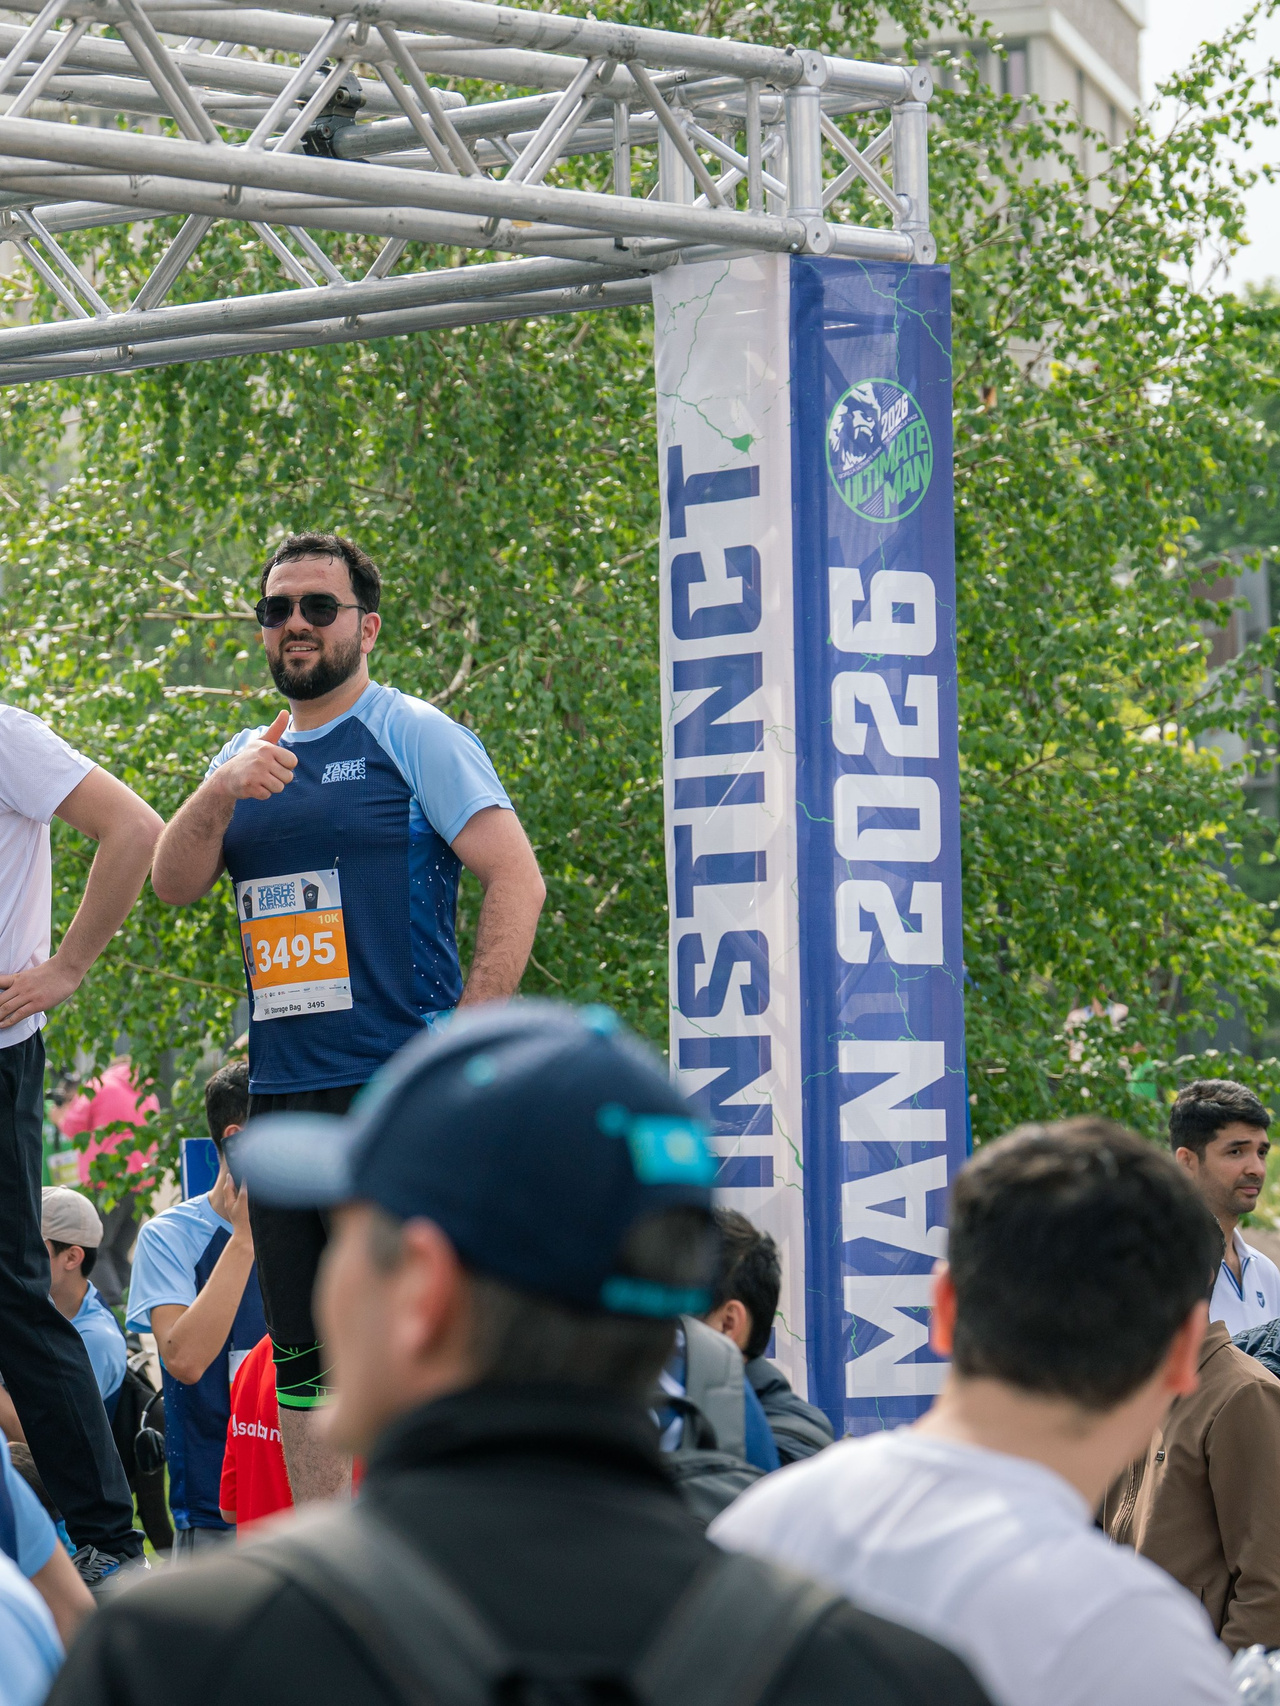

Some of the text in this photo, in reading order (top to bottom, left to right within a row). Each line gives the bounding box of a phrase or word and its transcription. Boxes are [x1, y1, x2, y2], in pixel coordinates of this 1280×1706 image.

[881, 393, 909, 441] 2026
[844, 419, 929, 507] ULTIMATE
[884, 453, 930, 518] MAN
[321, 770, 360, 783] KENT
[325, 761, 360, 774] TASH
[667, 444, 775, 1188] INSTINCT
[258, 884, 290, 899] TASH
[258, 895, 290, 909] KENT
[318, 913, 340, 925] 10K
[256, 931, 337, 973] 3495
[829, 566, 950, 1399] MAN 2026
[270, 1000, 326, 1014] Storage Bag 3495
